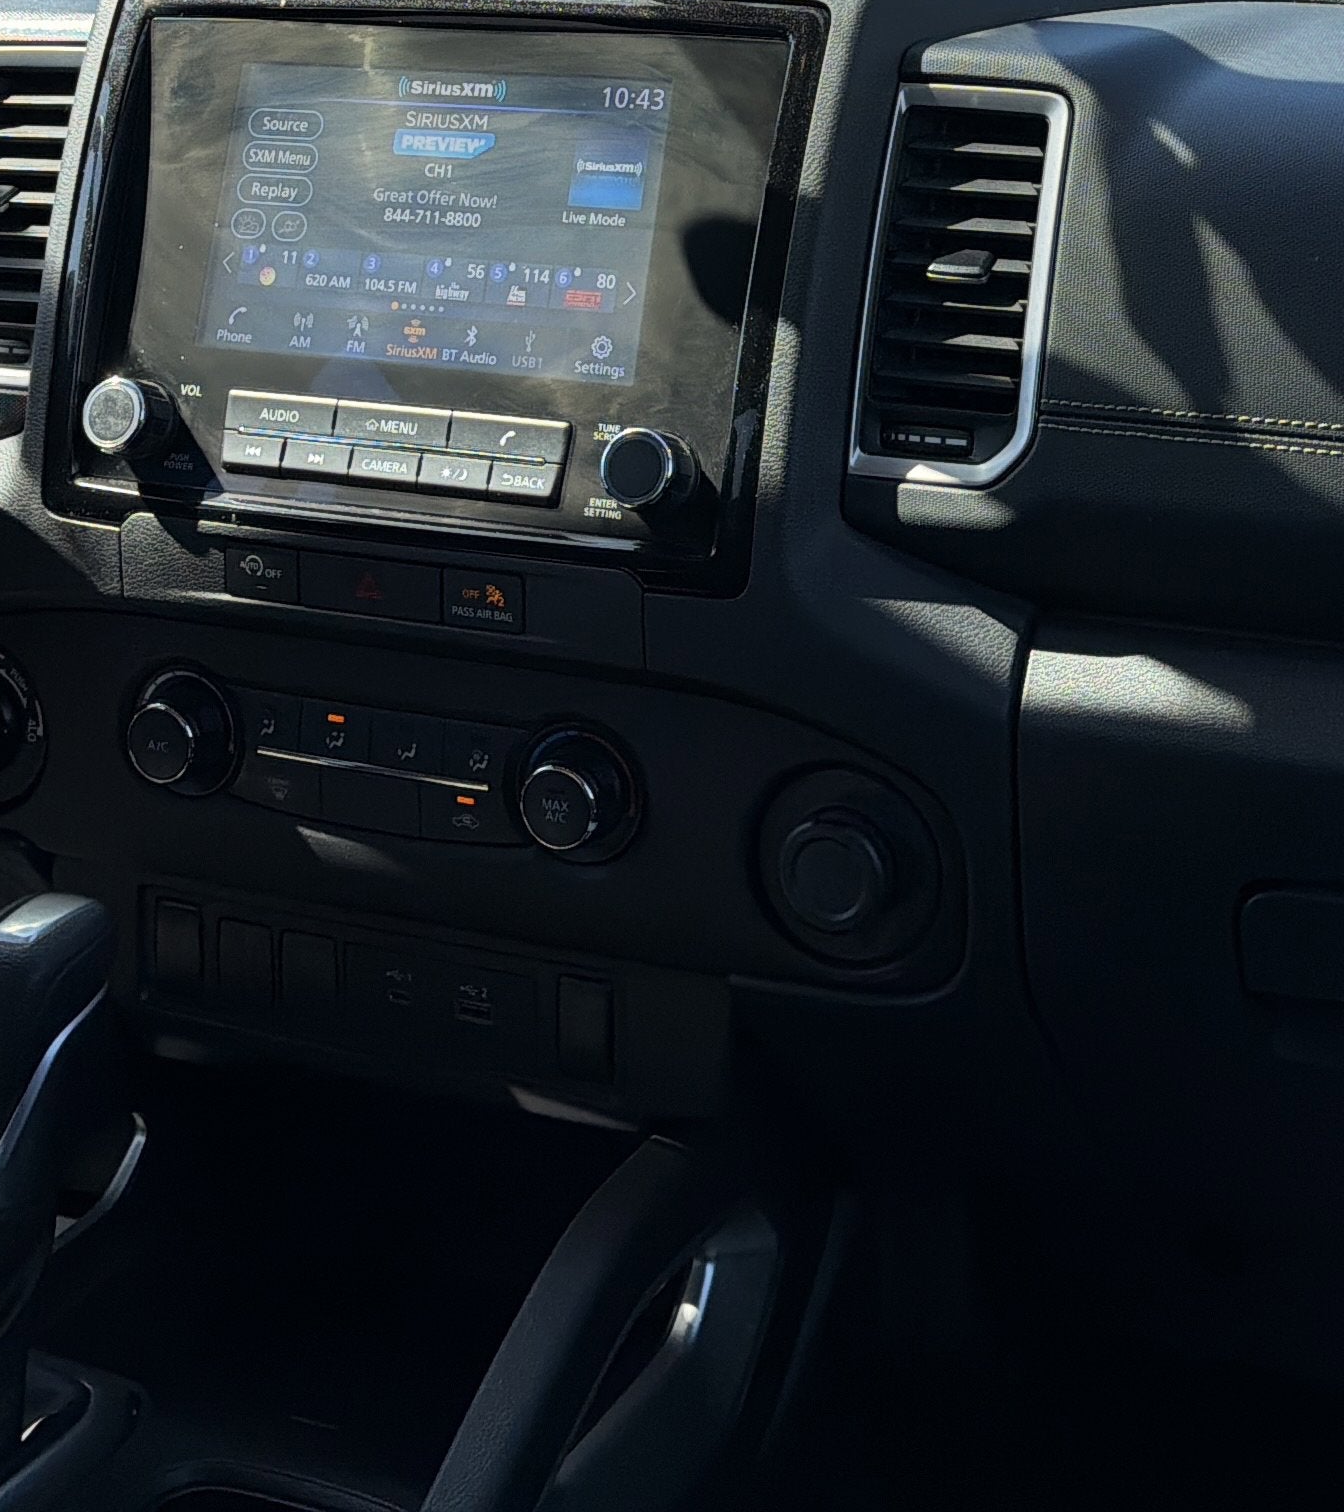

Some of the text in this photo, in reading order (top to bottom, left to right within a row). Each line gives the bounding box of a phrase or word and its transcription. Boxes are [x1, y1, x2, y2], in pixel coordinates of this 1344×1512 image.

[603, 86, 665, 111] 10:43
[262, 116, 309, 133] Source
[405, 110, 489, 131] SIRIUSXM
[401, 135, 486, 154] PREVIEW
[248, 148, 312, 167] SXM Menu
[424, 163, 453, 179] CH1
[251, 183, 299, 200] Replay
[373, 187, 498, 209] Great Offer Now!
[383, 207, 482, 228] 844-711-8800
[562, 210, 626, 227] Live Mode
[282, 250, 298, 265] 11
[368, 257, 376, 269] 3
[430, 262, 439, 274] 4
[467, 263, 486, 280] 56
[495, 268, 503, 279] 5
[524, 267, 550, 285] 114
[305, 273, 351, 289] 620 AM
[364, 277, 417, 294] 104.5 FM
[559, 272, 568, 284] 6
[596, 274, 616, 290] 80
[216, 329, 253, 344] Phone
[289, 336, 311, 348] AM
[346, 340, 366, 353] FM
[386, 344, 438, 360] SiriusXM
[441, 348, 497, 365] BT Audio
[574, 360, 625, 380] Settings
[180, 383, 203, 397] VOL
[258, 407, 300, 423] AUDIO
[379, 421, 419, 436] MENU
[598, 423, 622, 433] TUNE
[163, 460, 194, 471] POWER
[170, 452, 190, 463] PUSH
[361, 458, 408, 474] CAMERA
[513, 474, 546, 490] BACK
[589, 497, 618, 509] ENTER
[583, 507, 623, 520] SETTING
[264, 568, 283, 579] OFF
[462, 588, 481, 599] OFF
[451, 605, 514, 623] PASS AIR BAG
[145, 738, 169, 753] A/C
[541, 797, 570, 813] MAX
[545, 810, 568, 824] A/C
